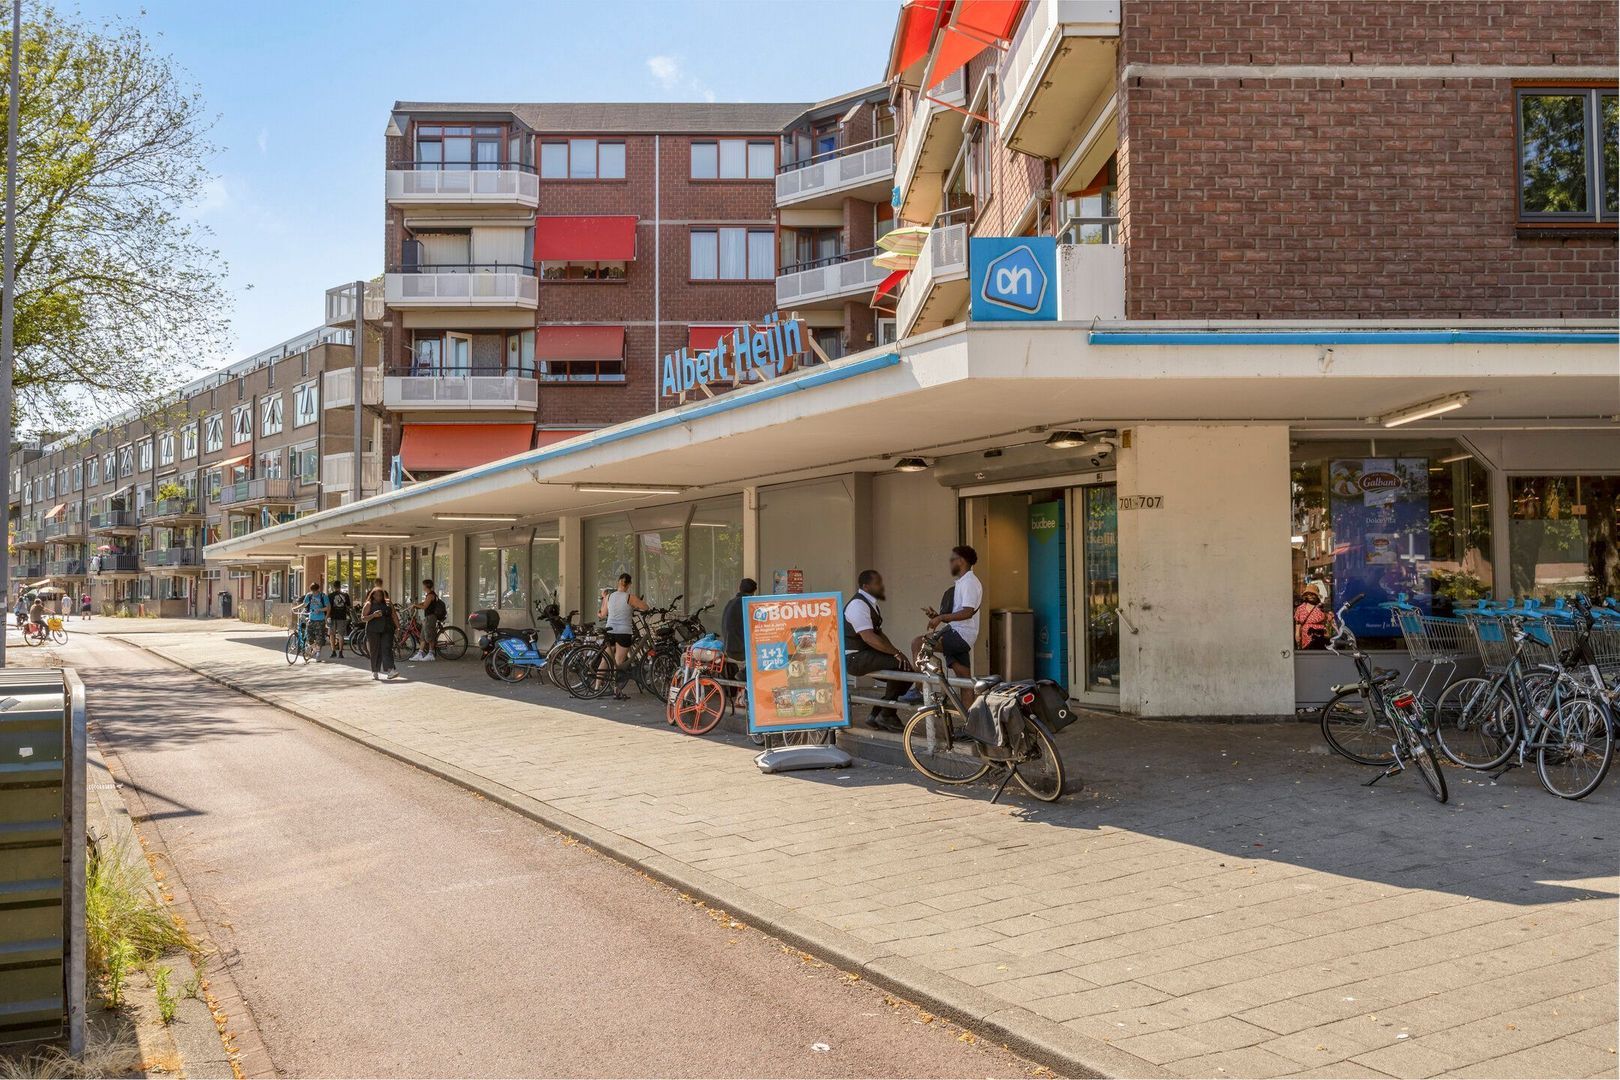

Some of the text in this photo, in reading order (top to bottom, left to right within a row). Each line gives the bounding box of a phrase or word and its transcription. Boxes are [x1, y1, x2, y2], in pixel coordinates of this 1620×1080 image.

[662, 311, 802, 397] Albert Heijn
[1363, 476, 1396, 488] Galbani
[1031, 517, 1056, 530] budbee
[768, 602, 832, 620] BONUS
[761, 647, 784, 659] 1+1
